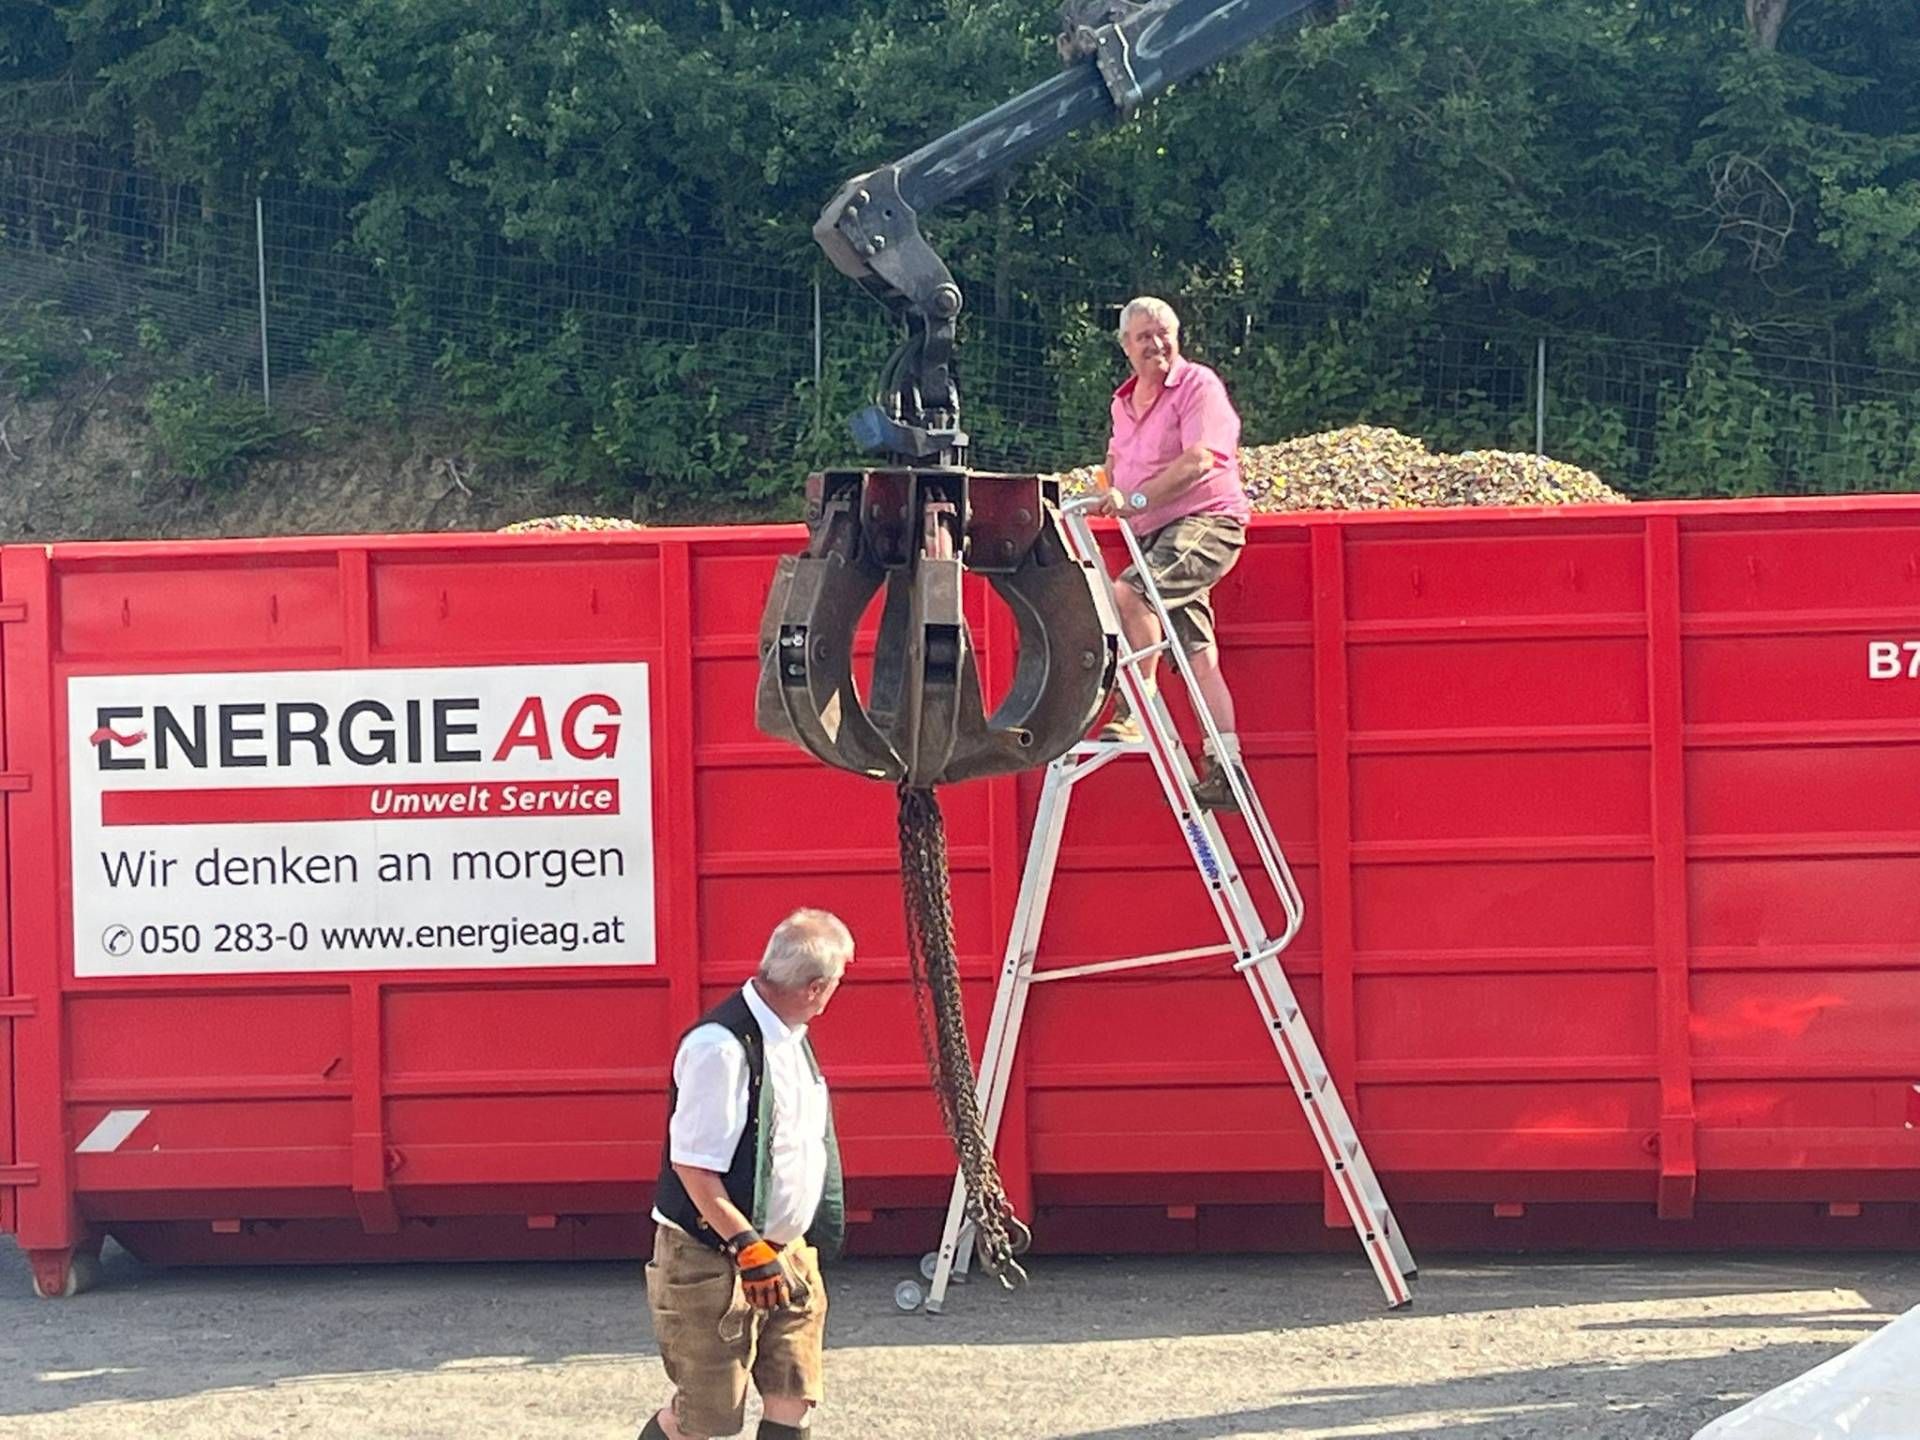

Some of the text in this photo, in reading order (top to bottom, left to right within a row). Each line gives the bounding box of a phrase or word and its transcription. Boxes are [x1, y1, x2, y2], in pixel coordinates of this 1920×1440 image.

[91, 694, 621, 771] ENERGIE AG
[370, 784, 612, 813] Umwelt Service
[101, 846, 625, 888] Wir denken an morgen
[140, 916, 625, 953] 050 283-0 www.energieag.at
